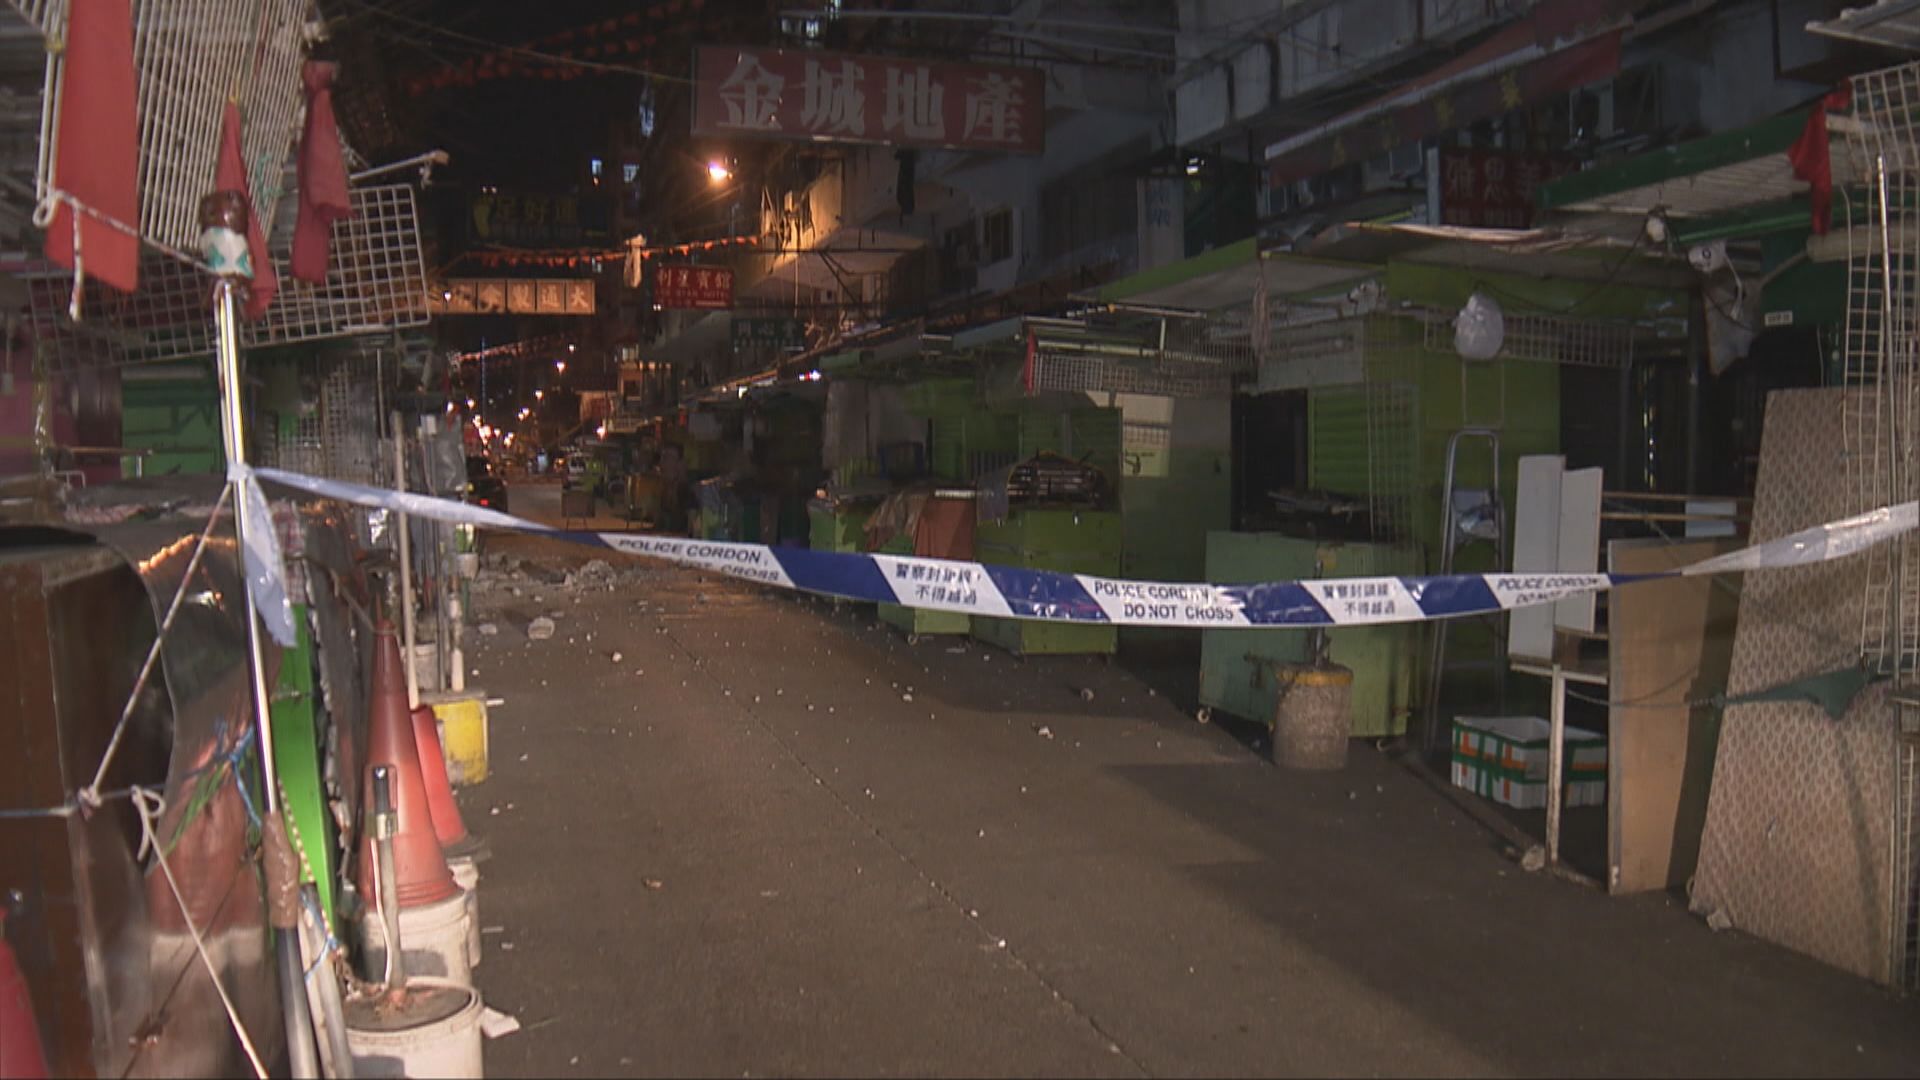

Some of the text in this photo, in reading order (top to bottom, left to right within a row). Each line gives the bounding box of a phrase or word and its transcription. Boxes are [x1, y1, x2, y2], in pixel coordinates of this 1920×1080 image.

[716, 52, 1024, 144] 金城地產
[619, 539, 682, 554] POLICE
[721, 564, 779, 581] CROSS
[1095, 581, 1145, 599] POLICE
[1497, 577, 1545, 591] POLICE
[1125, 603, 1234, 621] DO NOT CROSS
